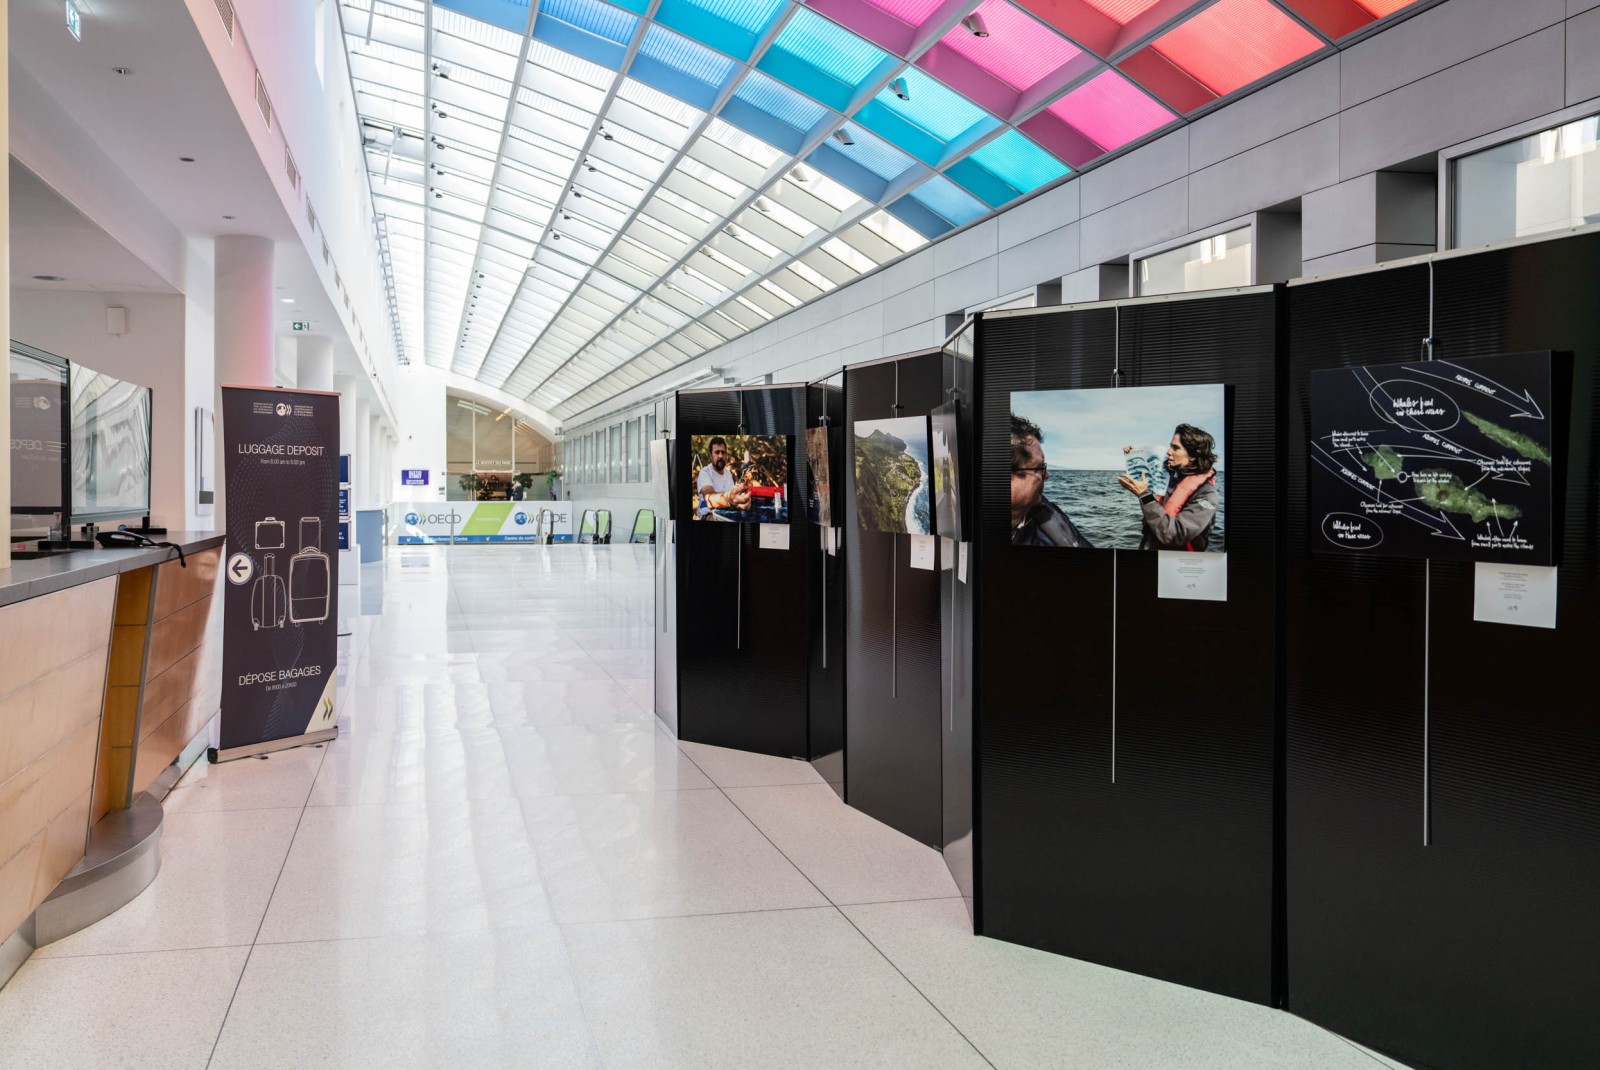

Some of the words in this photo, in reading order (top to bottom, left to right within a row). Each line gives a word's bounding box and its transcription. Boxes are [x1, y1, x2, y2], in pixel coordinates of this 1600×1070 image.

[238, 444, 285, 455] LUGGAGE
[287, 446, 324, 456] DEPOSIT
[428, 514, 461, 524] OECD
[238, 671, 277, 686] DÉPOSE
[278, 666, 321, 680] BAGAGES
